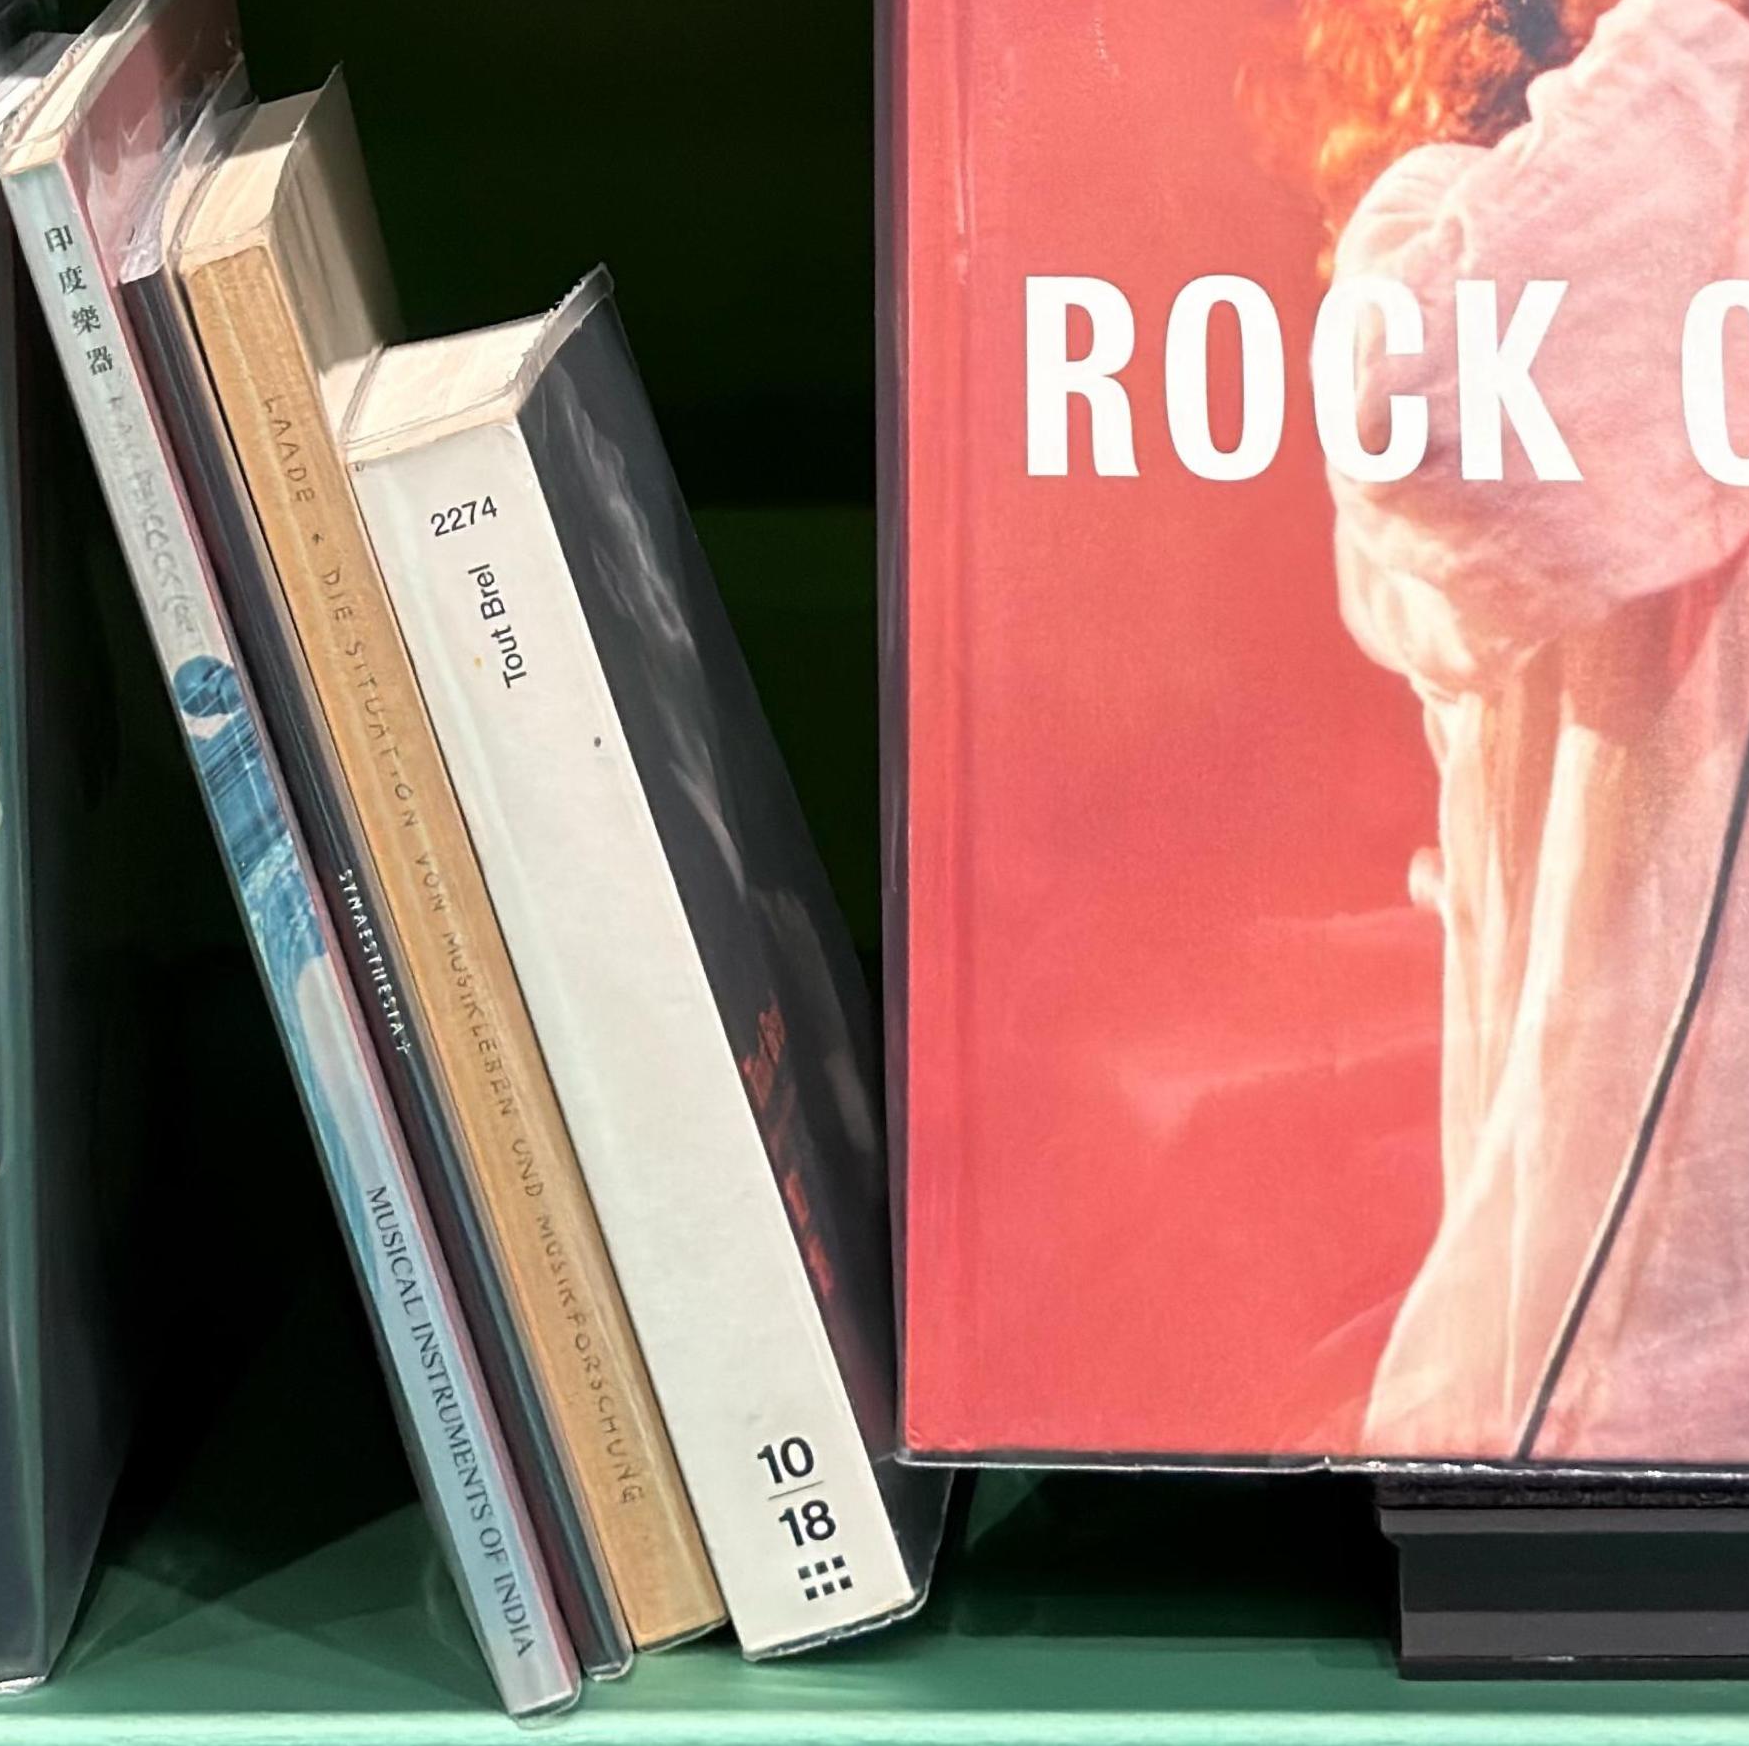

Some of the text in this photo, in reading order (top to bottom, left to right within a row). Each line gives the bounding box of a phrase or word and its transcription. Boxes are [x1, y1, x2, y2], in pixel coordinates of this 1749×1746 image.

[44, 226, 114, 374] 印度樂器
[1024, 274, 1586, 483] ROCK
[430, 496, 499, 537] 2274
[468, 563, 528, 689] Tout Brel
[264, 394, 647, 1507] LAADE DIE SITUATION VON MUSIKLEBEN UND MUSIKFORSCHUNG
[366, 1185, 535, 1658] MUSICAL INSTRUMENTS OF INDIA
[757, 1435, 815, 1487] 10
[778, 1498, 837, 1549] 18
